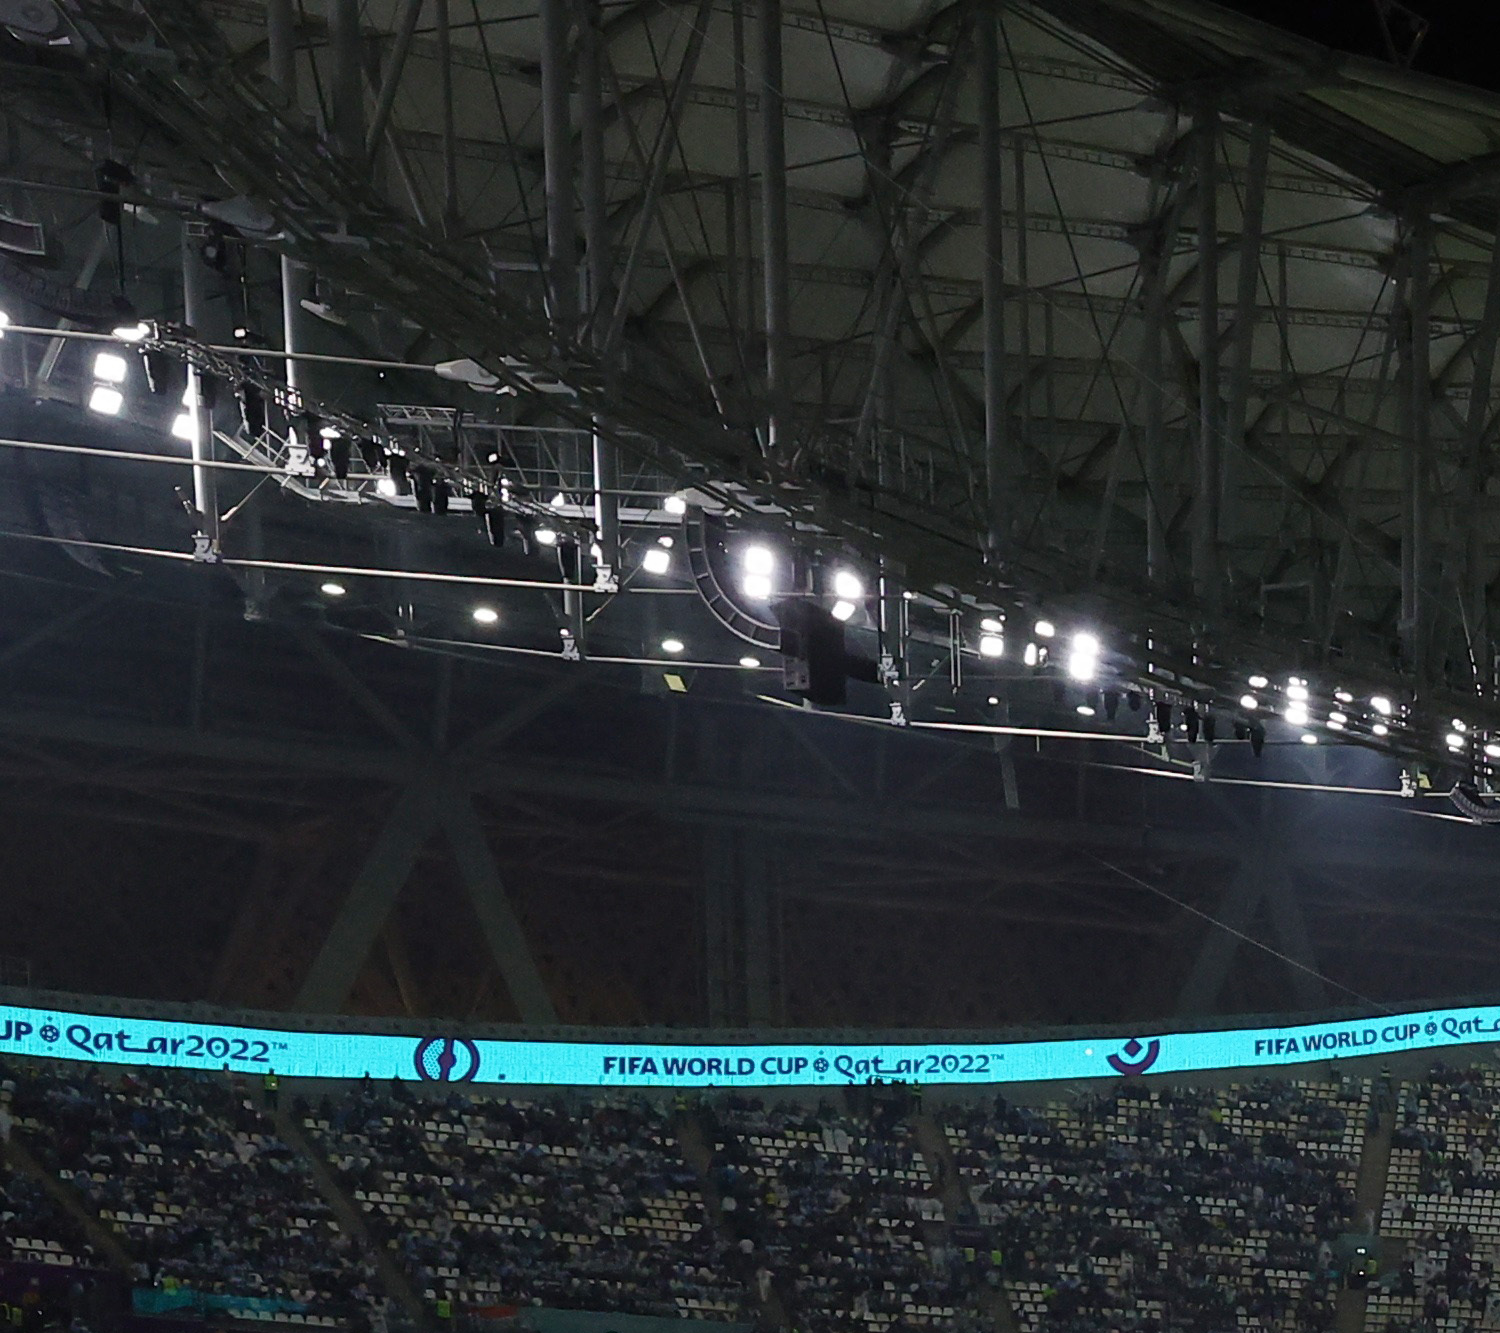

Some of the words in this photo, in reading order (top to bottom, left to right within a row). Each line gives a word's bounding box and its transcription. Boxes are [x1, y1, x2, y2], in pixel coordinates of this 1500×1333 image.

[1254, 1039, 1300, 1056] FIFA
[1304, 1029, 1377, 1051] WORLD
[1381, 1023, 1420, 1041] CUP
[603, 1056, 659, 1076] FIFA
[663, 1056, 755, 1077] WORLD
[761, 1056, 809, 1076] CUP
